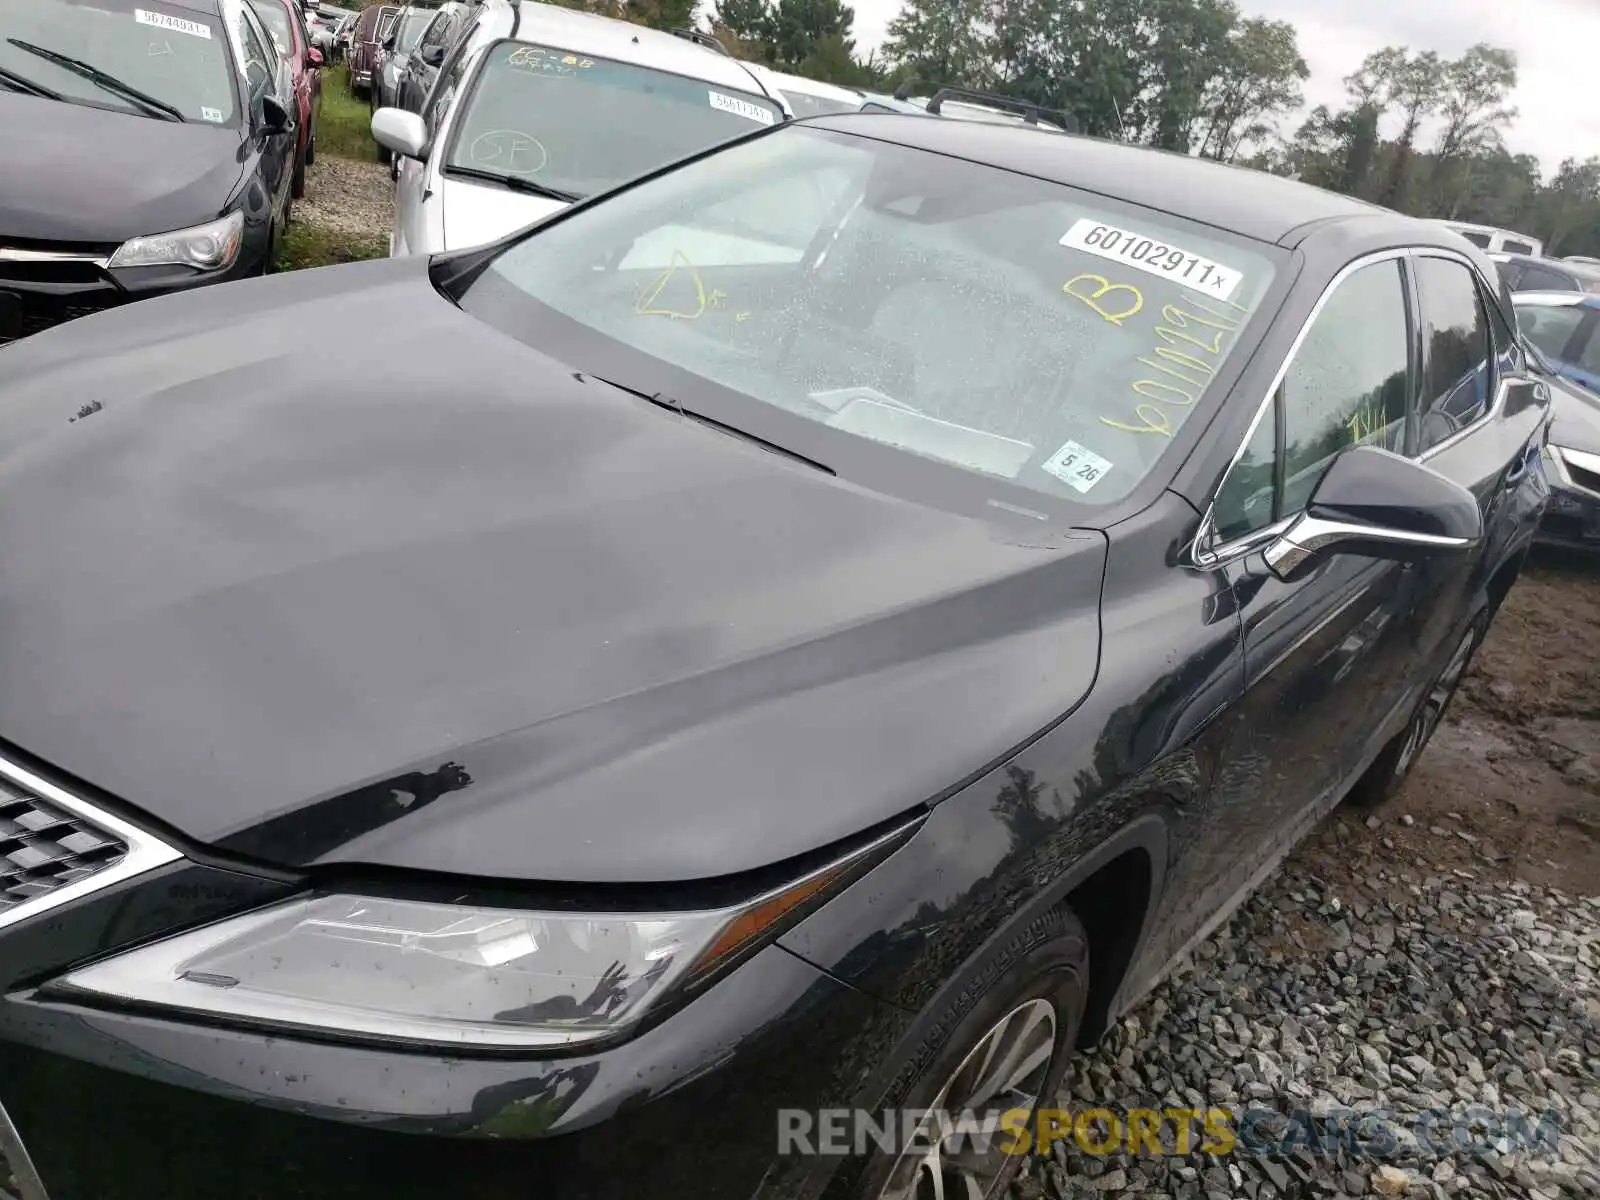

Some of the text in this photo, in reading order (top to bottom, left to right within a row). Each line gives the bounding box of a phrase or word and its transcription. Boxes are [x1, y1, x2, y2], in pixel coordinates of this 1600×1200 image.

[143, 10, 206, 34] 56744931
[1060, 453, 1078, 467] 5
[1075, 463, 1101, 482] 26
